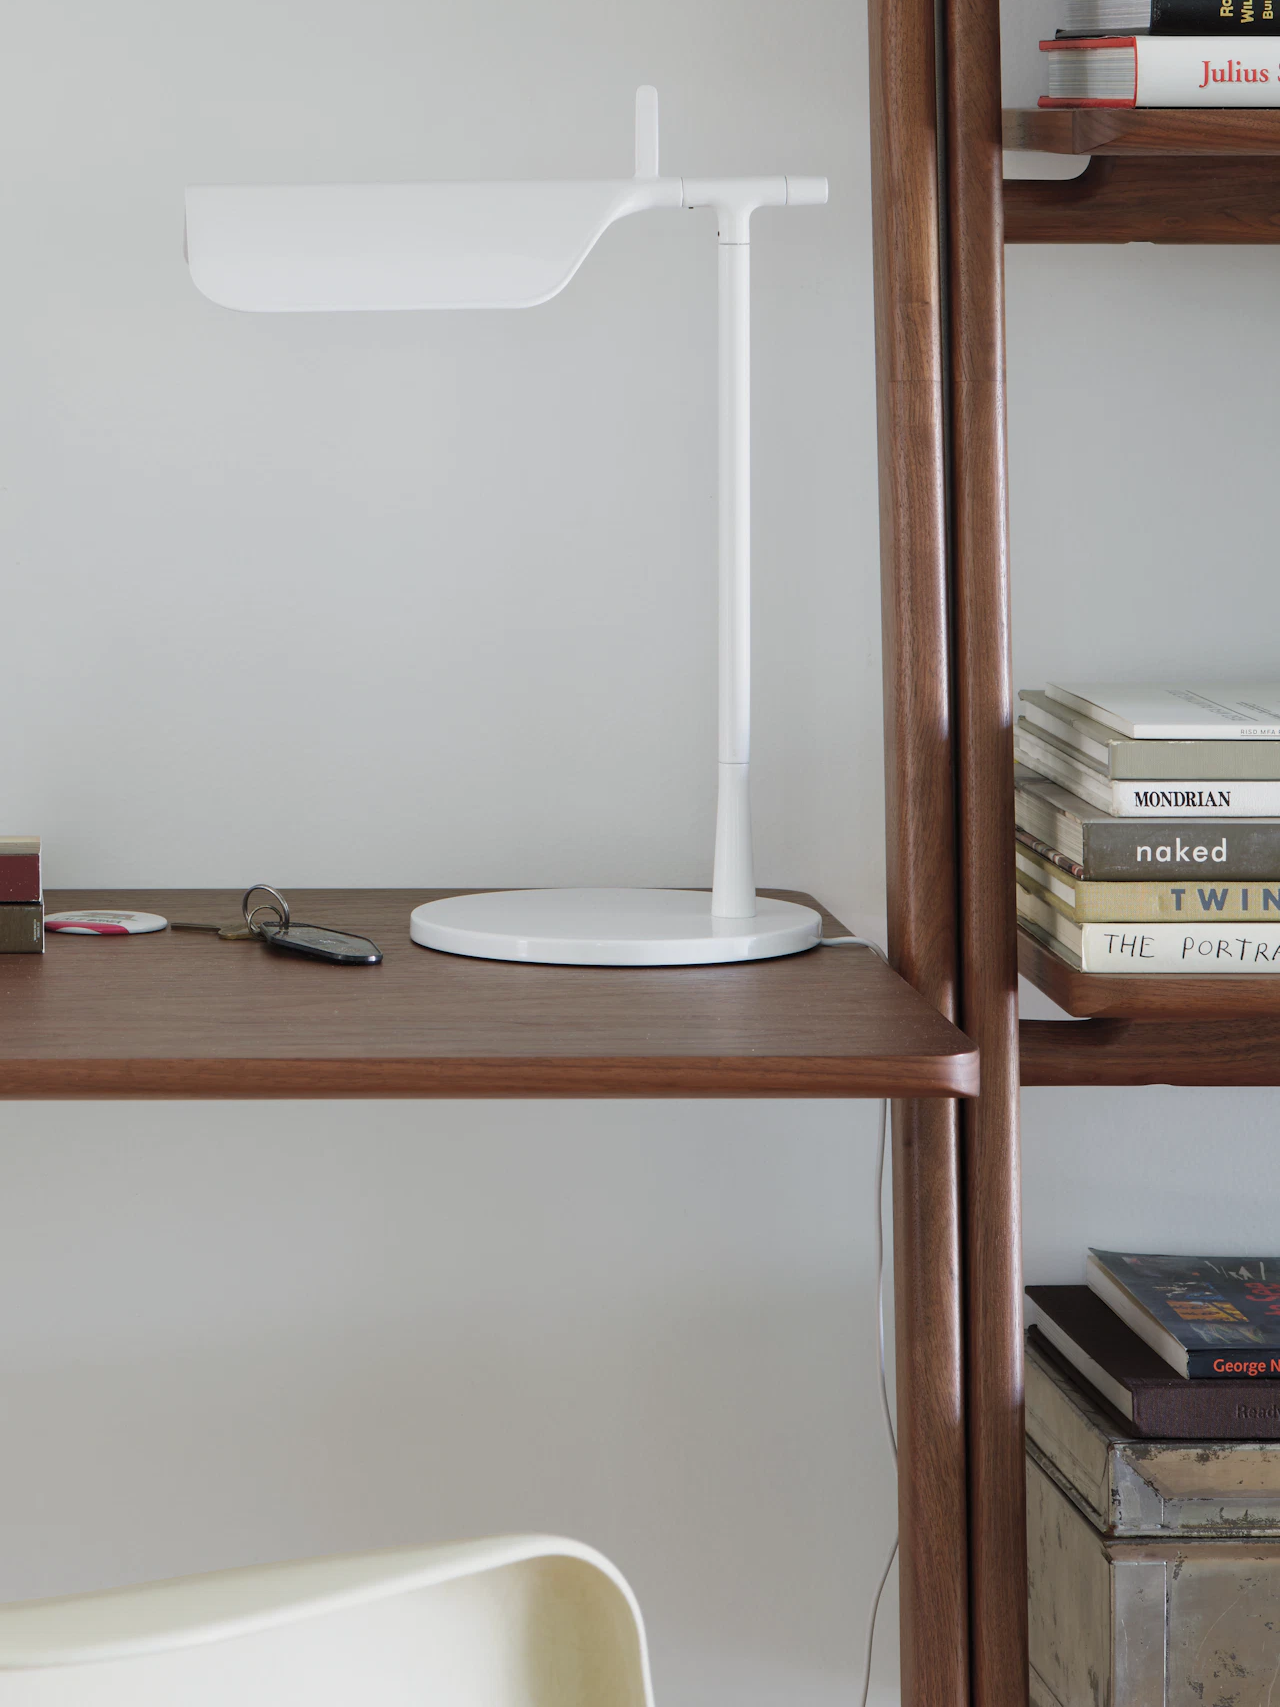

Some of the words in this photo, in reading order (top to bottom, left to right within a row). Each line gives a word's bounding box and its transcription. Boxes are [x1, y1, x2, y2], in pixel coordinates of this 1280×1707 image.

[1198, 59, 1269, 88] Julius
[1134, 790, 1231, 808] MONDRIAN
[1136, 837, 1227, 863] naked
[1170, 888, 1280, 911] TWIN
[1104, 932, 1155, 959] THE
[1213, 1358, 1267, 1377] George
